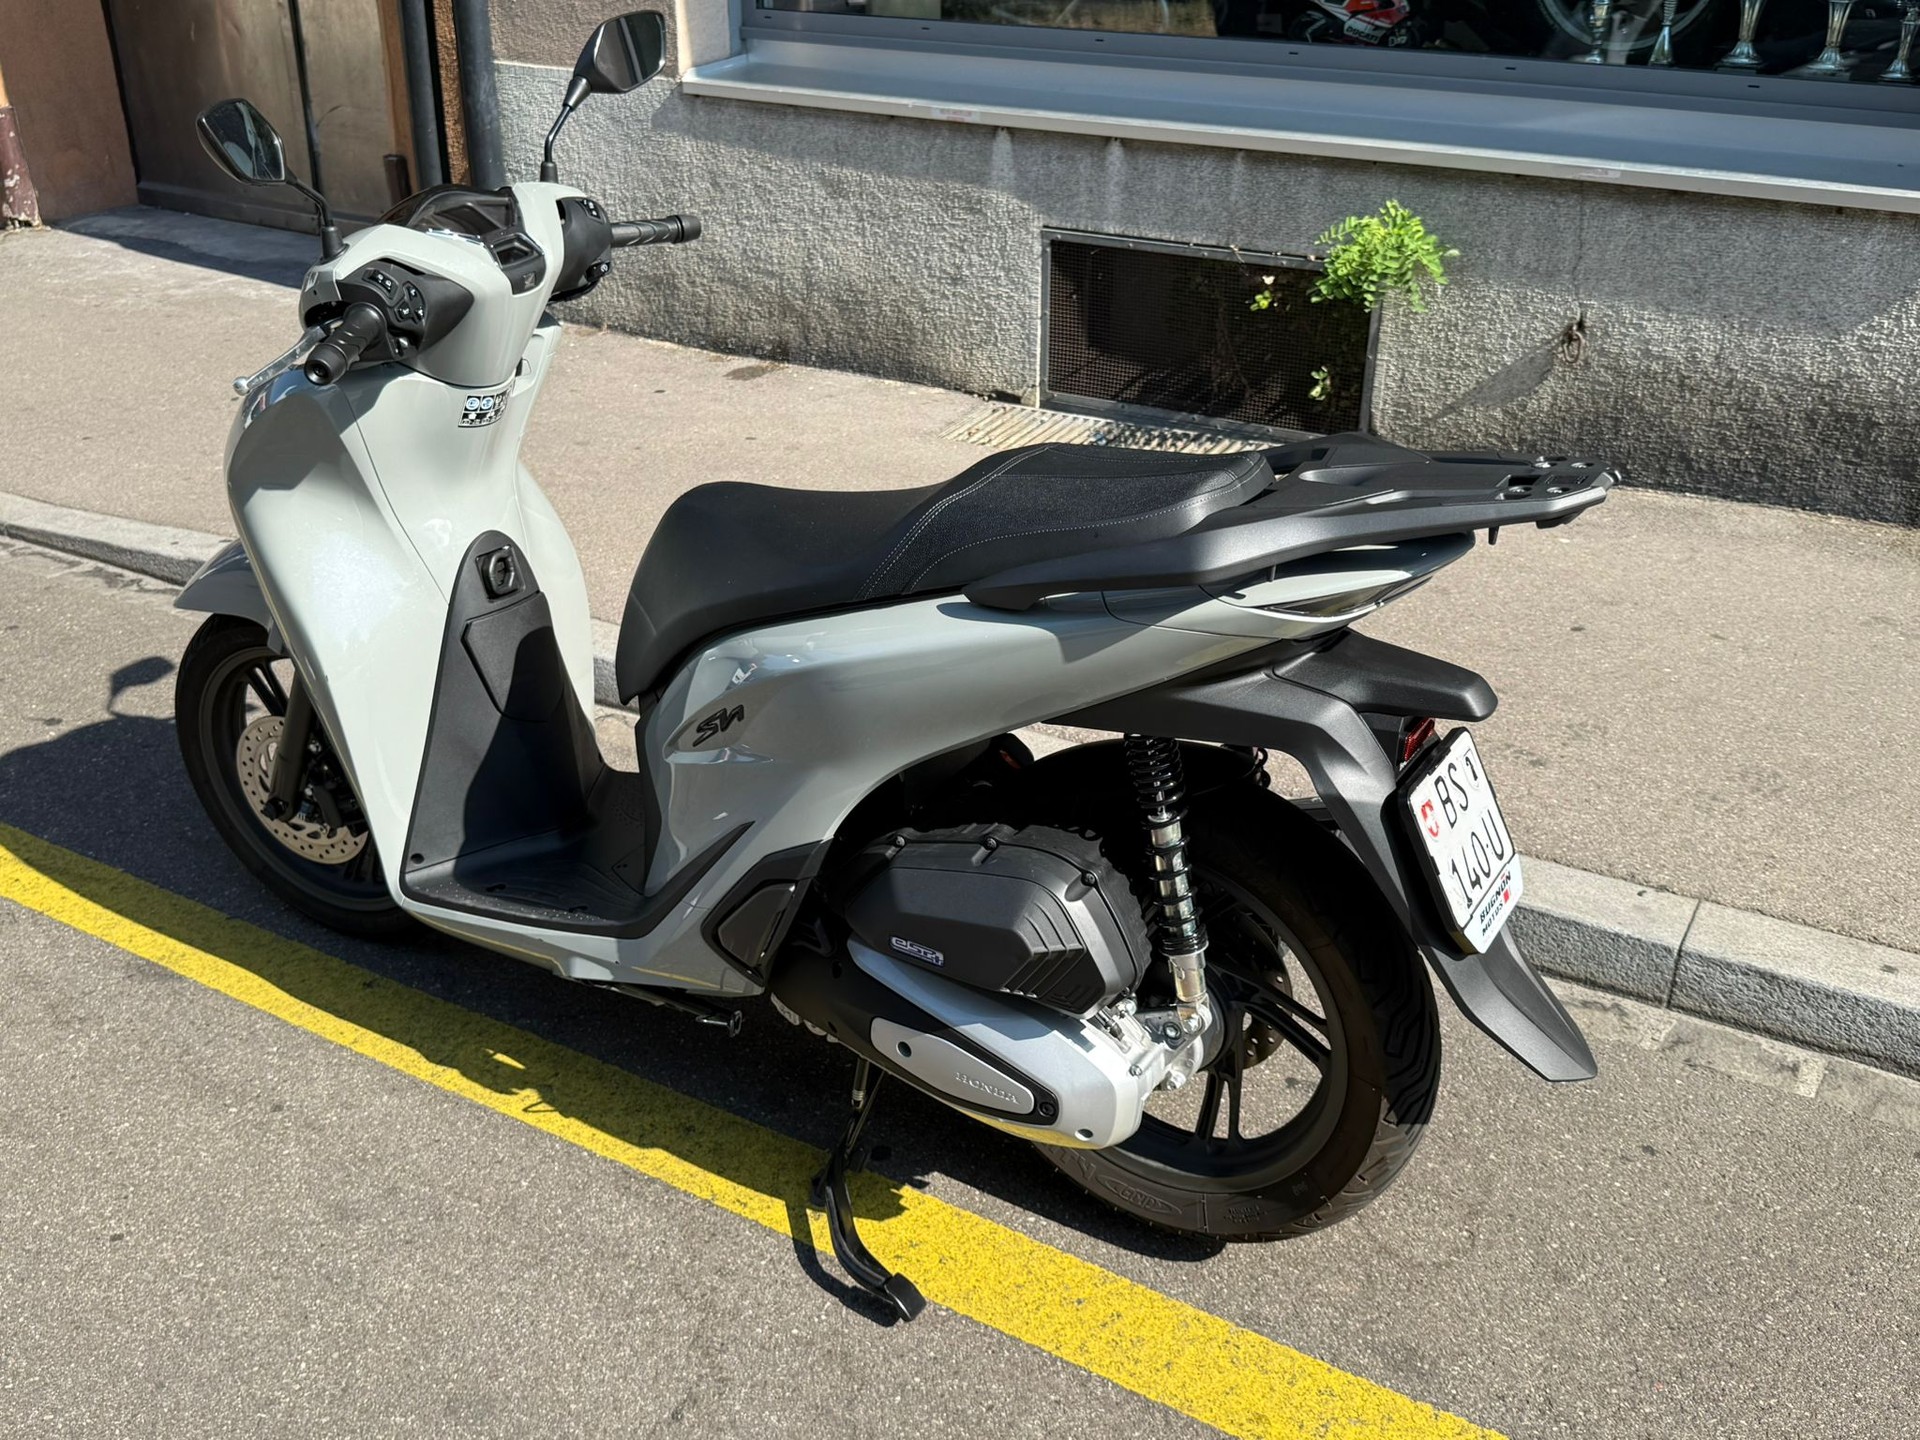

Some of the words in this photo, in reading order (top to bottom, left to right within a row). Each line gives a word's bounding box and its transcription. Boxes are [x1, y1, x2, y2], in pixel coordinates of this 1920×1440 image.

[1434, 762, 1469, 829] BS
[1480, 871, 1511, 924] BUGNON
[954, 1070, 1020, 1105] HONDA
